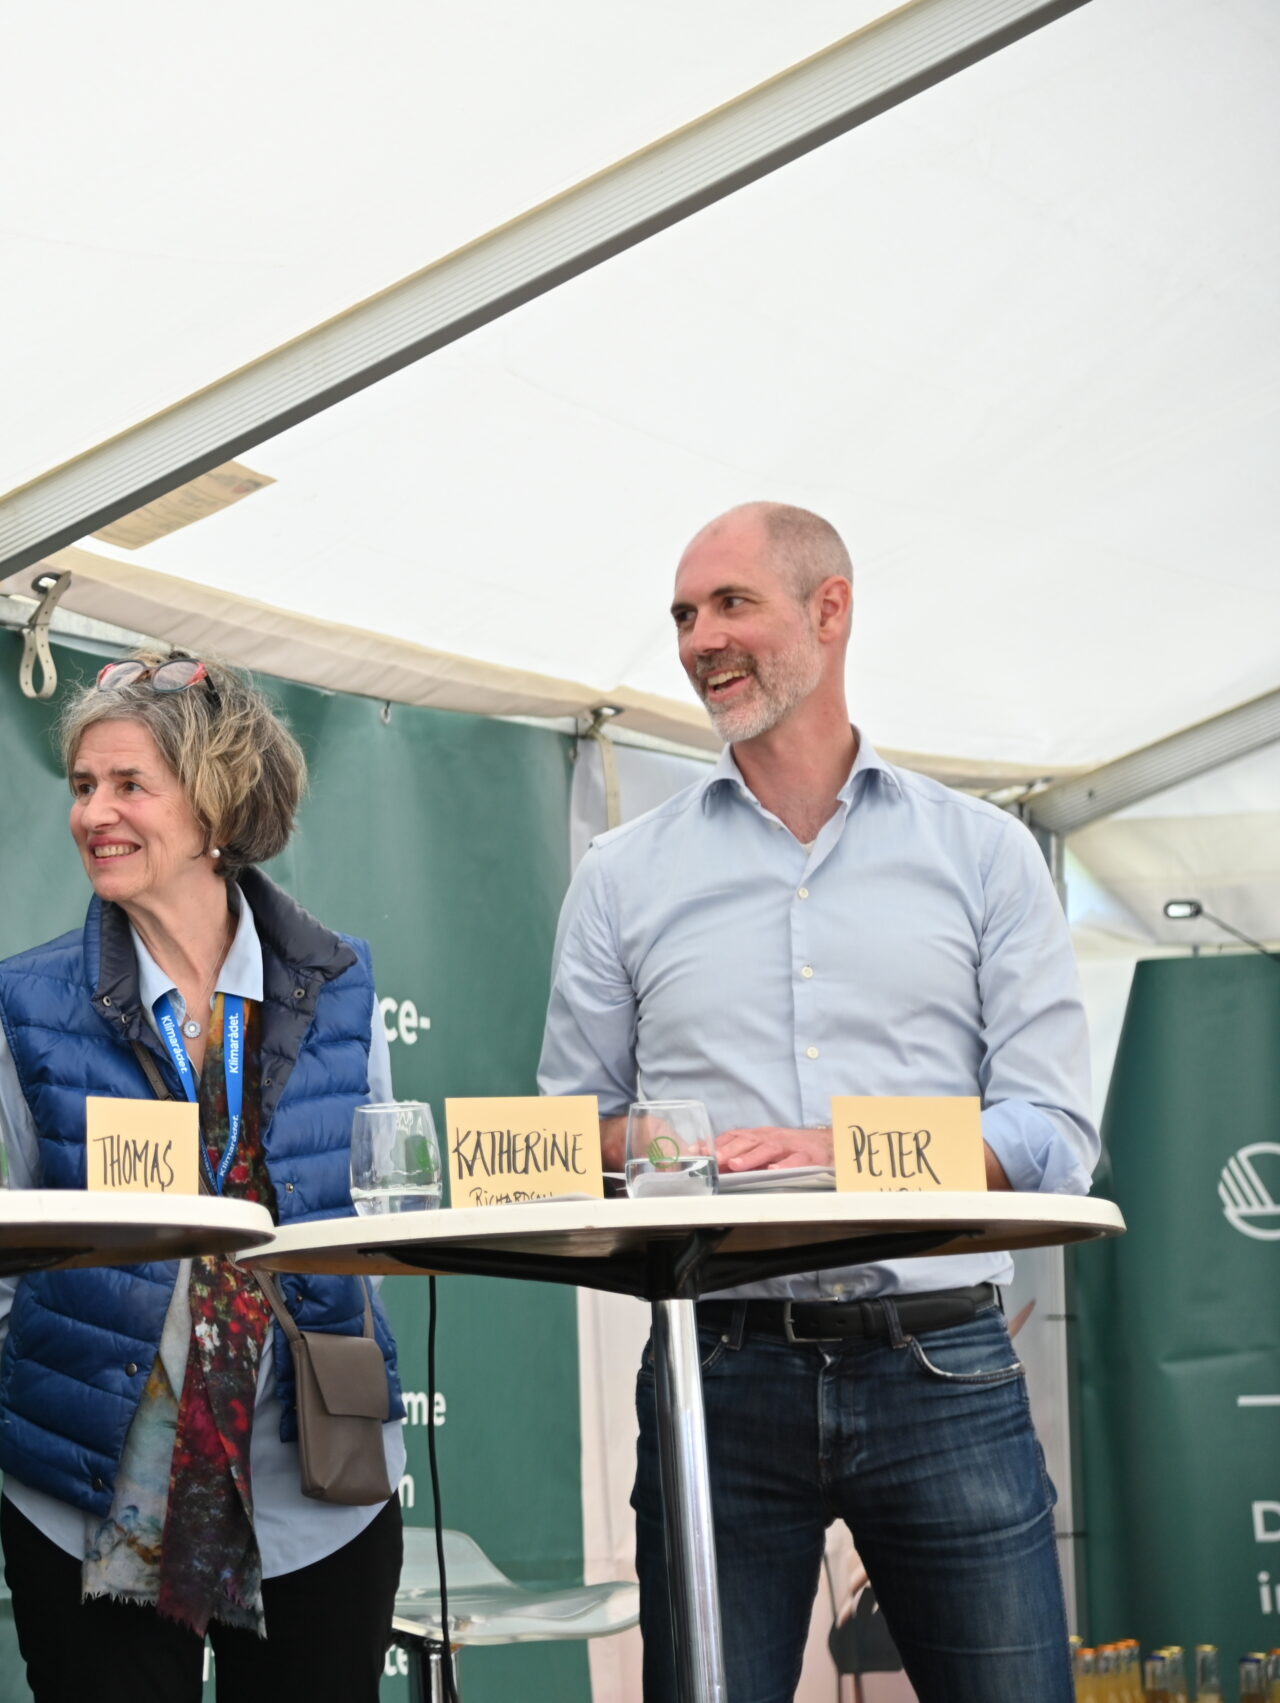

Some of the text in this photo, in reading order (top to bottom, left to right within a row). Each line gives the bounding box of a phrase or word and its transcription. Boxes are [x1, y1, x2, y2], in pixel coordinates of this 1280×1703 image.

[160, 1014, 188, 1075] Klimarådet.
[229, 1012, 240, 1074] Klimarådet.
[93, 1134, 175, 1191] THOMAS
[848, 1124, 942, 1185] PETER
